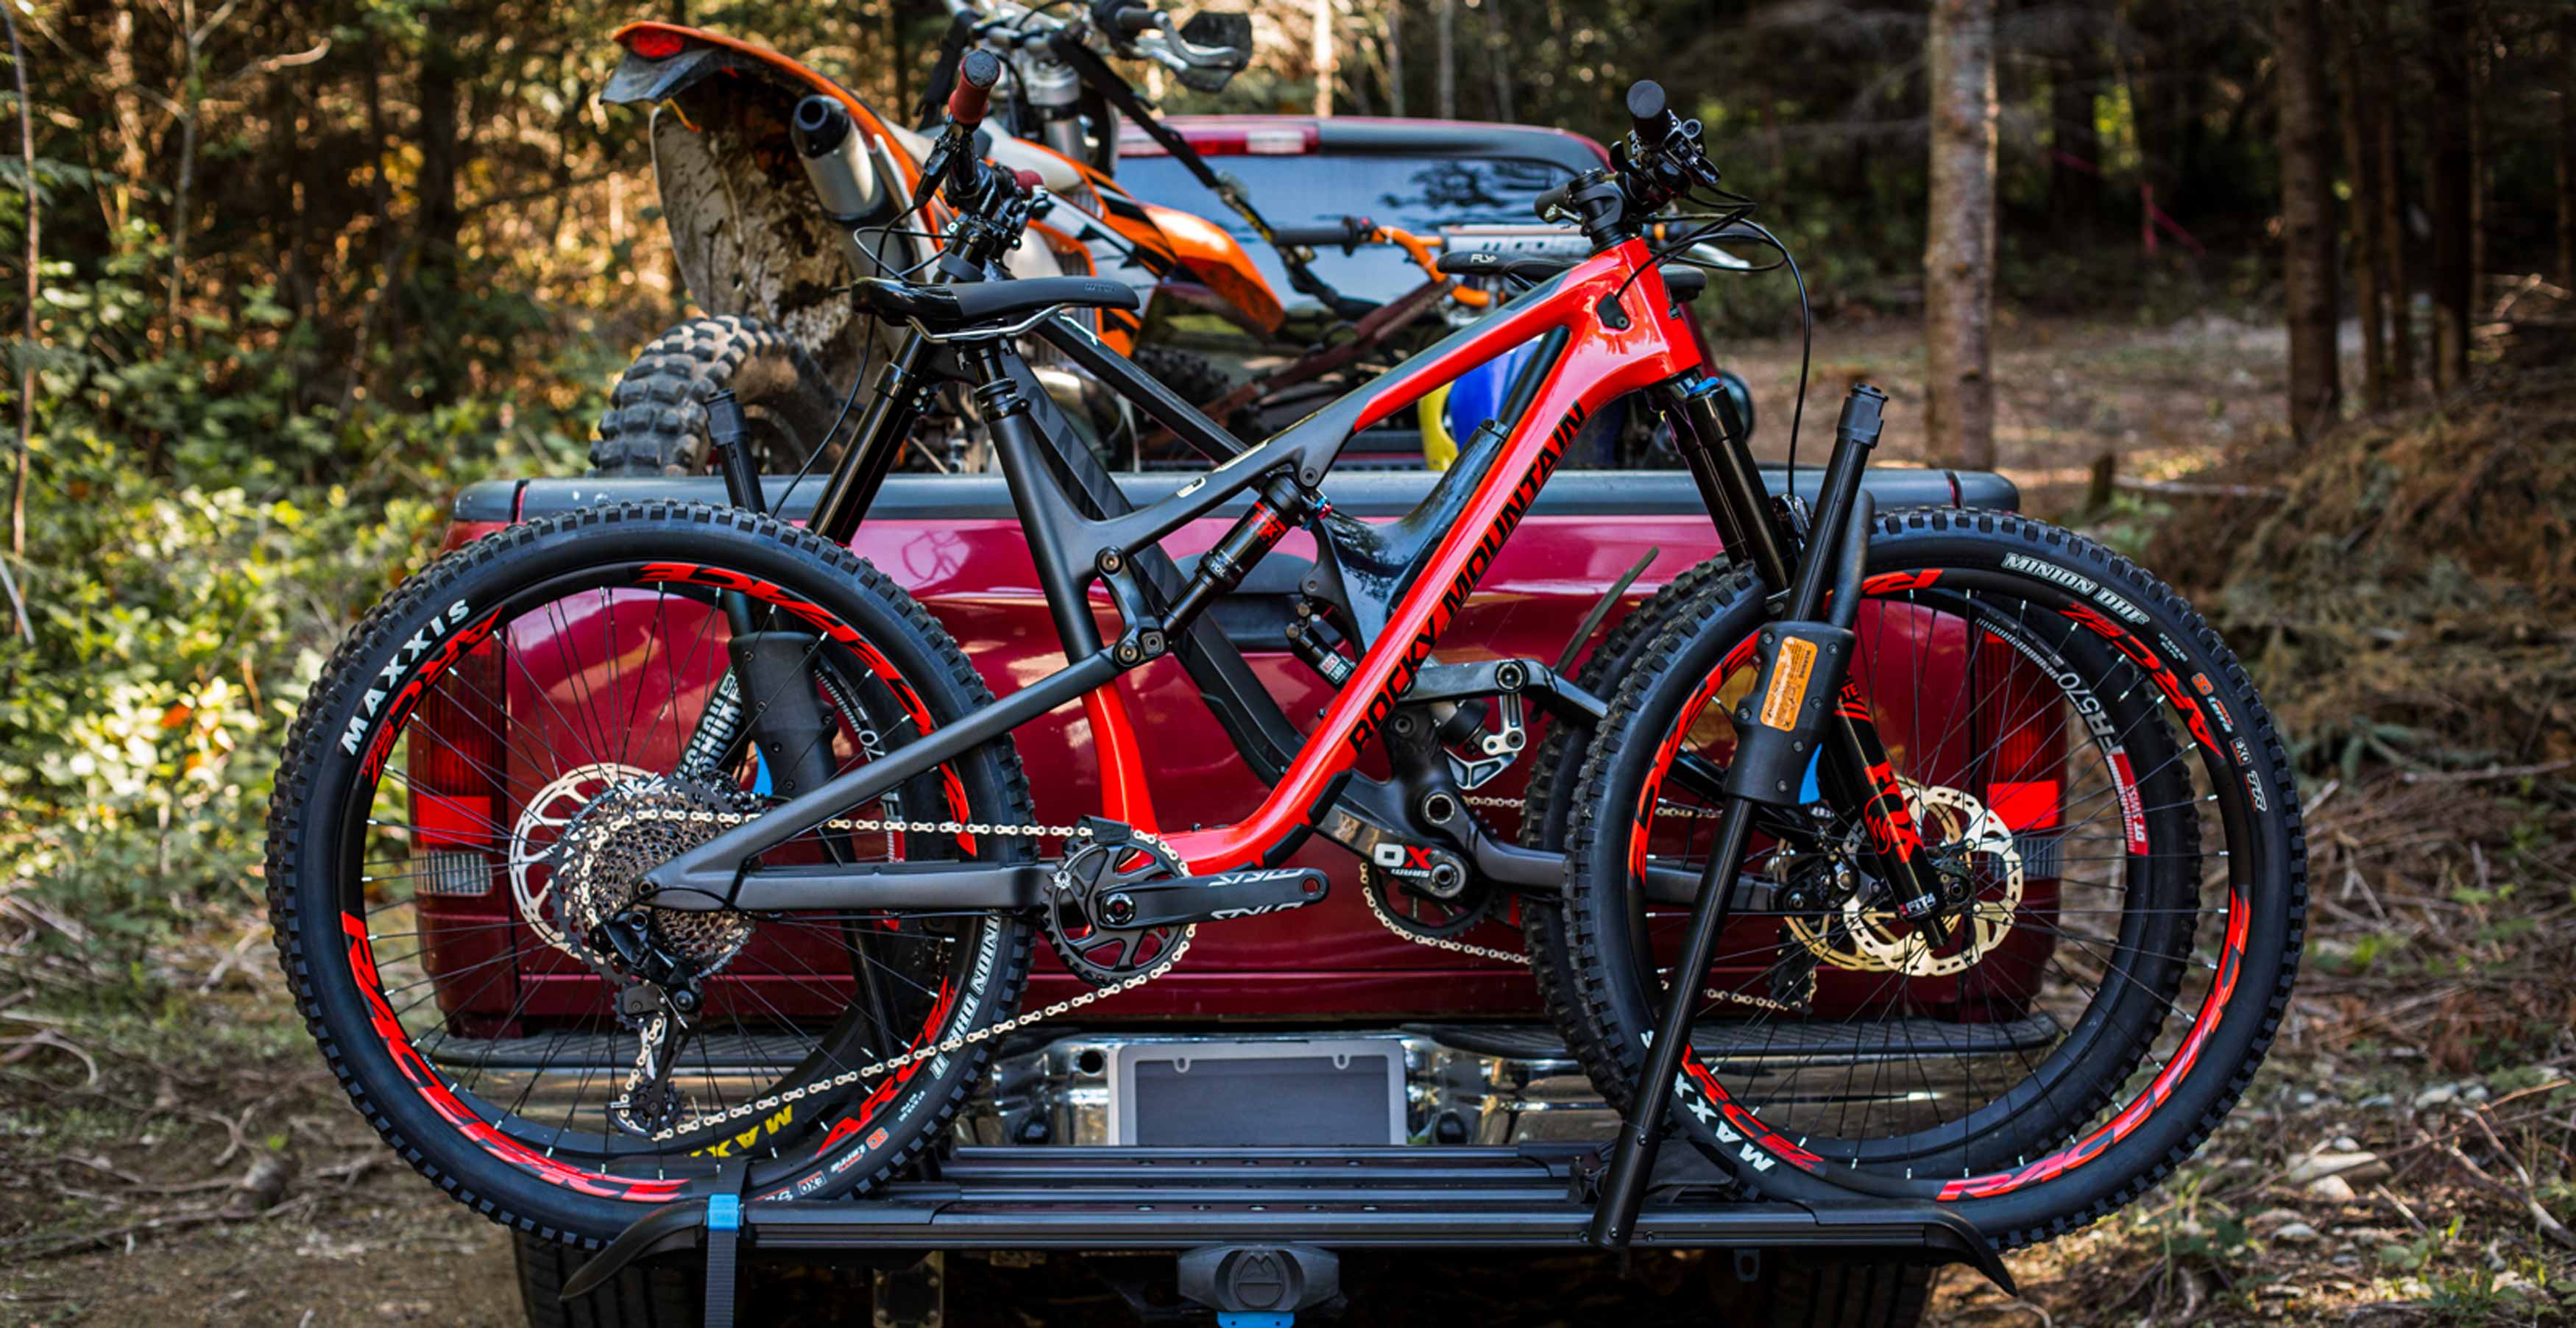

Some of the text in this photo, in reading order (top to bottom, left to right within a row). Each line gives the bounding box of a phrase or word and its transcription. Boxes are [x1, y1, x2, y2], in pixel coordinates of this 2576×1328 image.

[1348, 400, 1585, 756] ROCKY MOUNTAIN
[2000, 552, 2098, 597] MINION
[341, 599, 470, 756] MAXXIS
[1864, 760, 1924, 863] FOX
